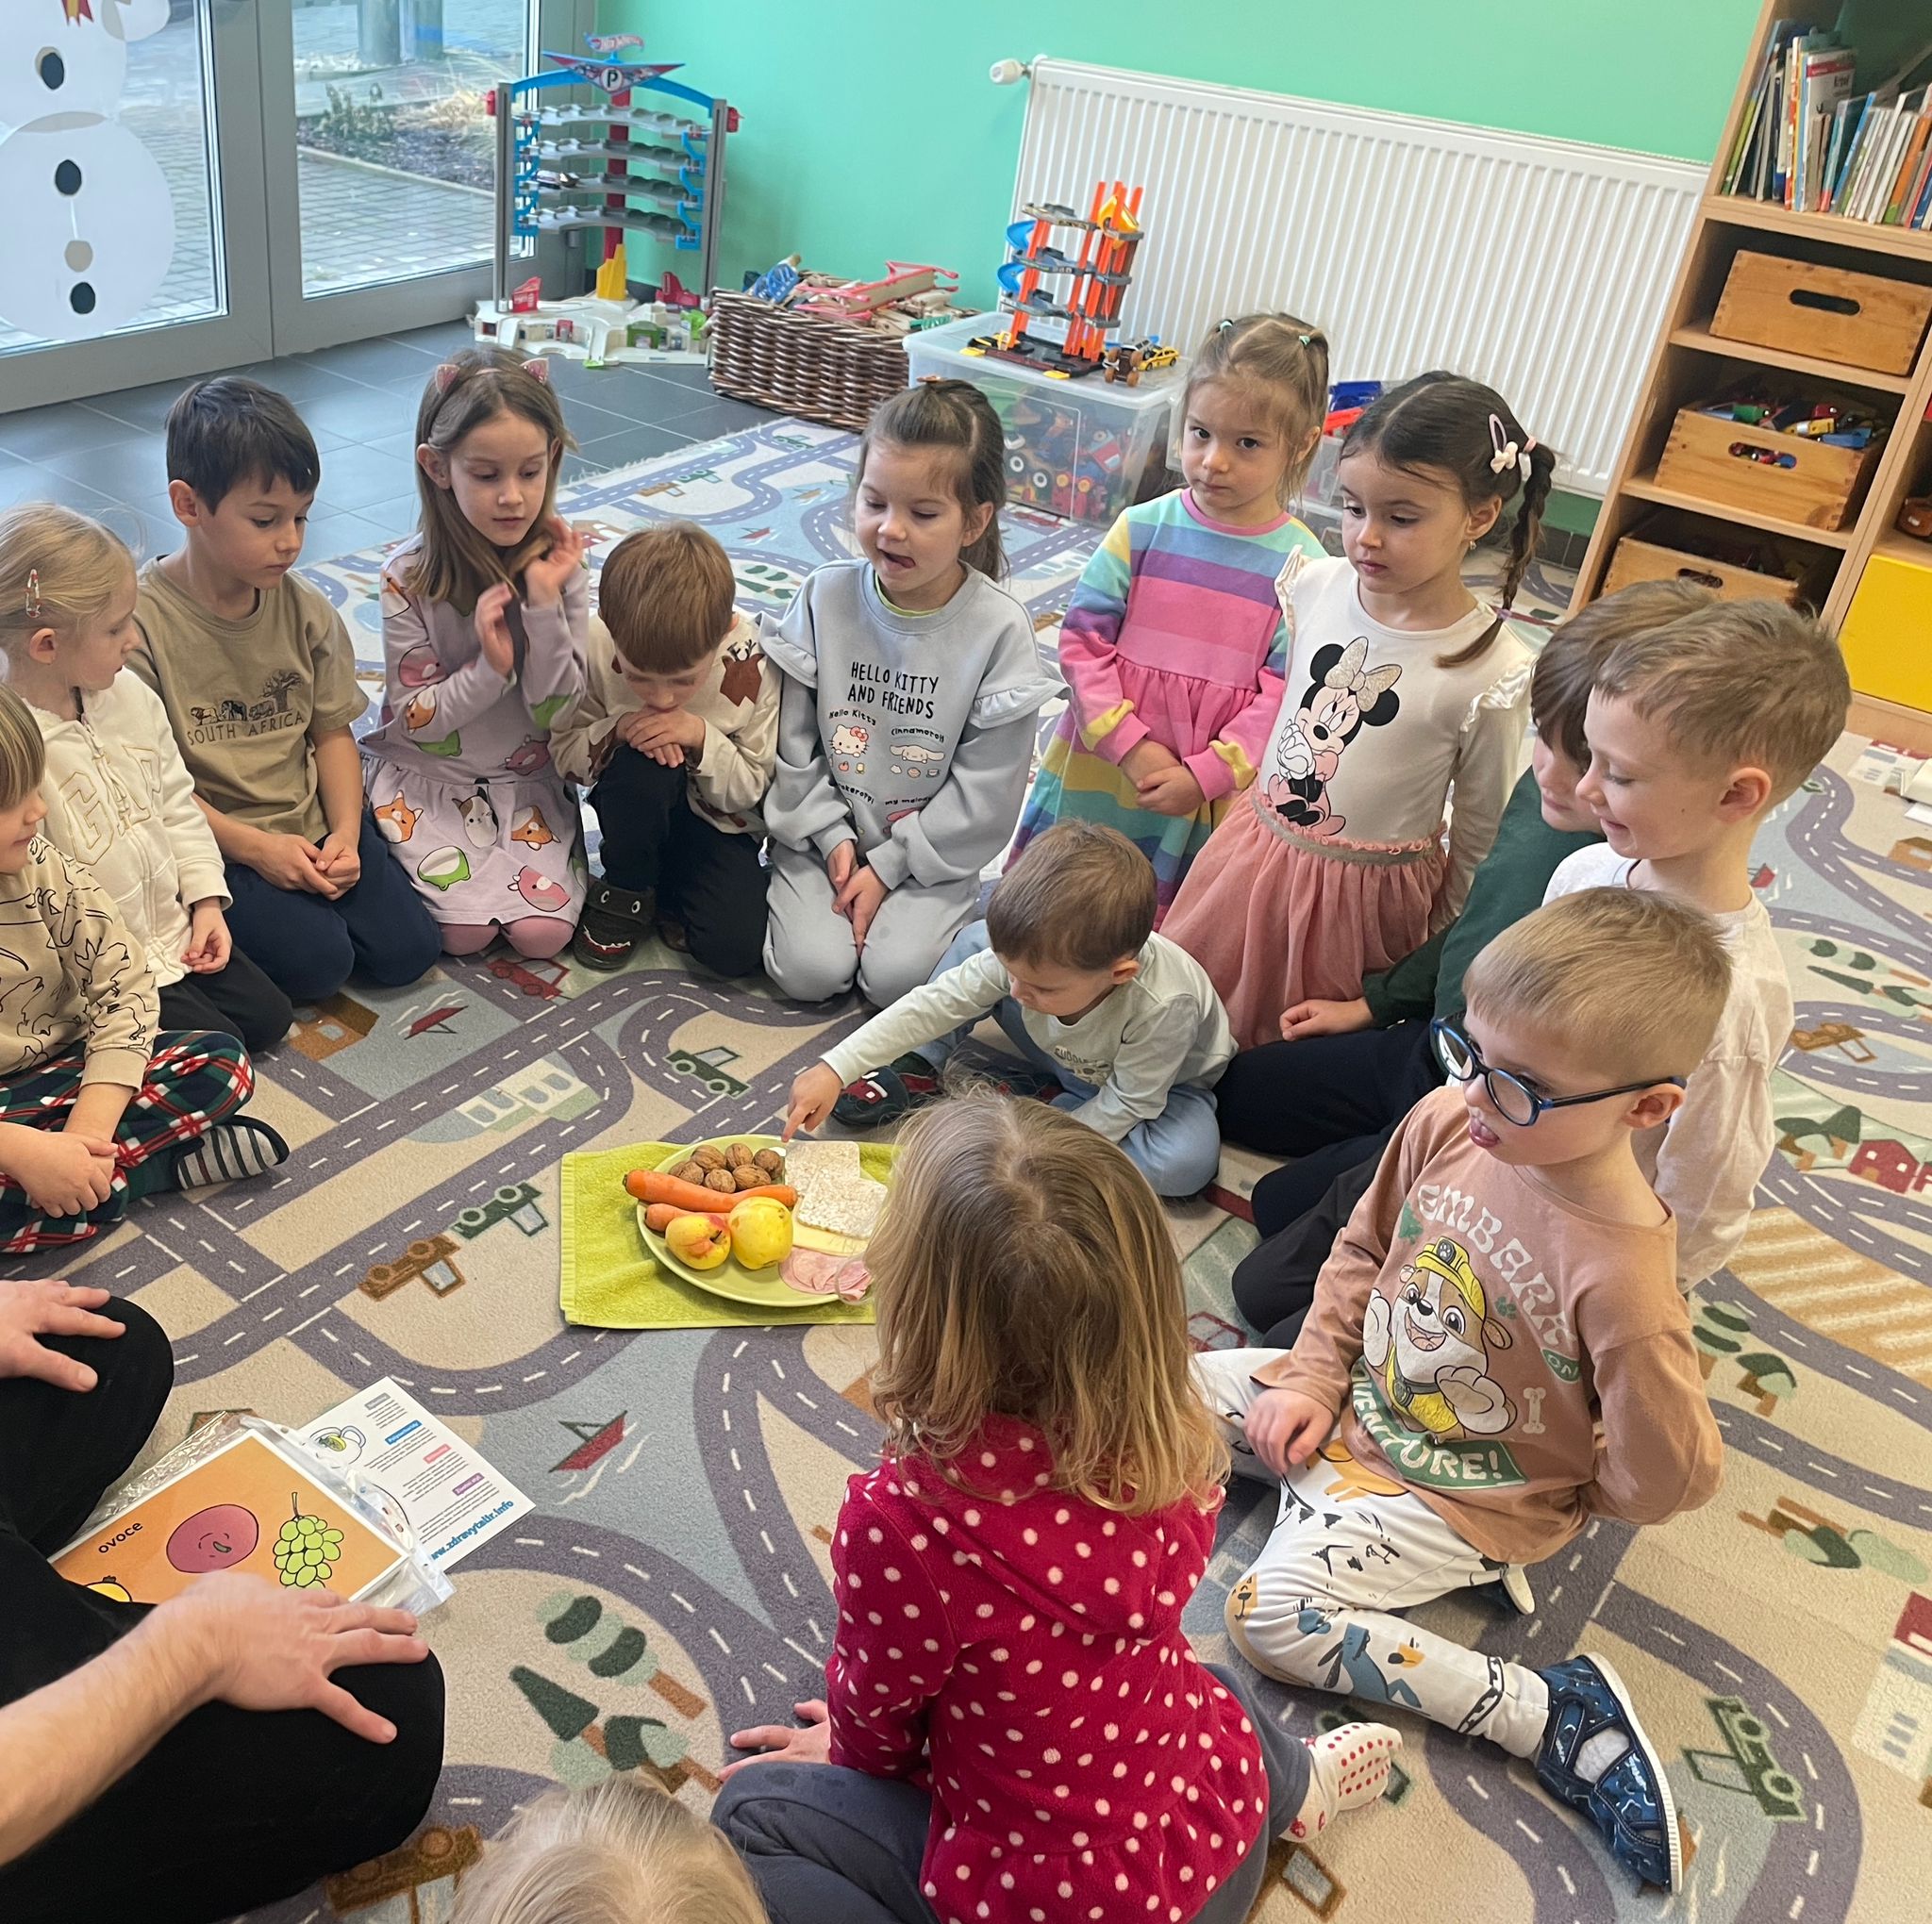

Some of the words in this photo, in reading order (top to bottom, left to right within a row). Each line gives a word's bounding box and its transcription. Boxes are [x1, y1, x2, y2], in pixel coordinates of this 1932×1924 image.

[608, 70, 618, 88] P
[851, 661, 891, 684] HELLO
[894, 671, 940, 694] KITTY
[847, 684, 875, 704] AND
[881, 690, 935, 719] FRIENDS
[187, 723, 236, 746] SOUTH
[247, 709, 305, 737] AFRICA
[1417, 1184, 1578, 1348] EMBARK
[98, 1522, 143, 1553] ovoce
